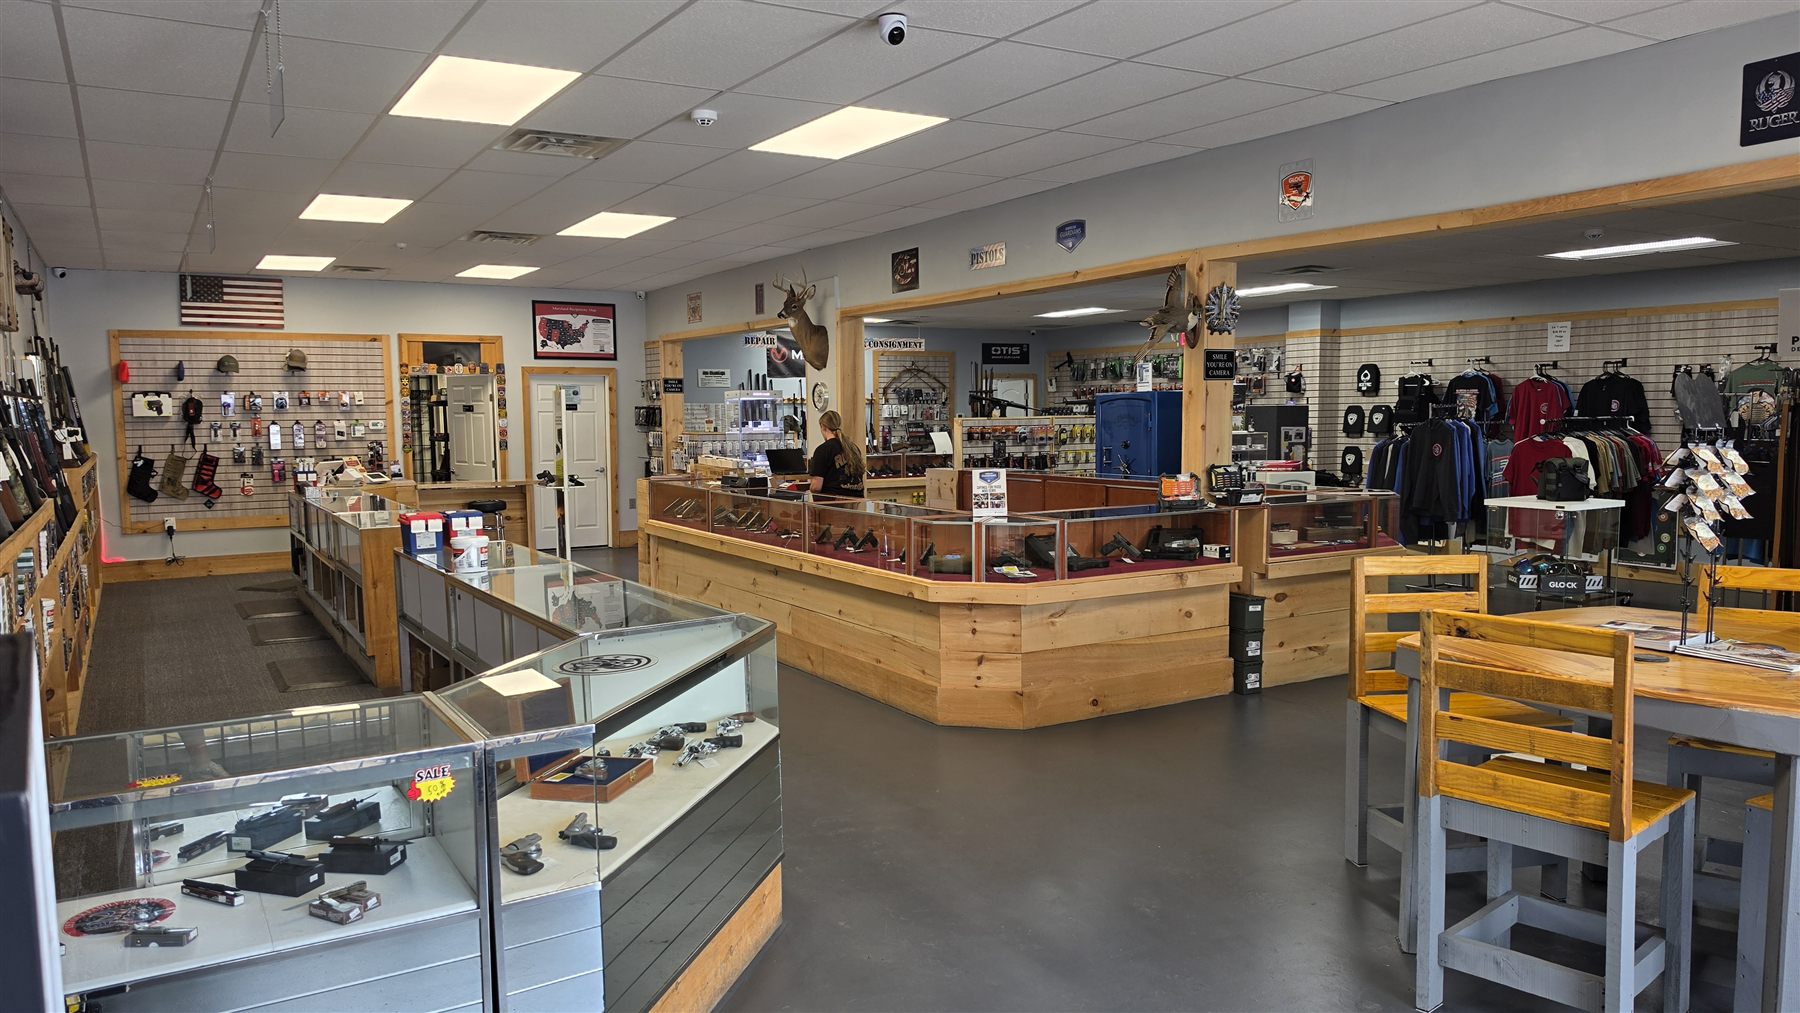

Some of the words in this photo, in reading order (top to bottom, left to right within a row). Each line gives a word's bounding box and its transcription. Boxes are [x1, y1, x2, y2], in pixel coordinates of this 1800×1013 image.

[1748, 111, 1800, 132] RUGER
[970, 247, 1004, 266] PISTOLS
[744, 336, 776, 345] REPAIR
[868, 340, 923, 349] CONSIGNMENT
[991, 346, 1021, 355] OTIS
[1548, 581, 1578, 589] GLOCK
[415, 764, 451, 783] SALE
